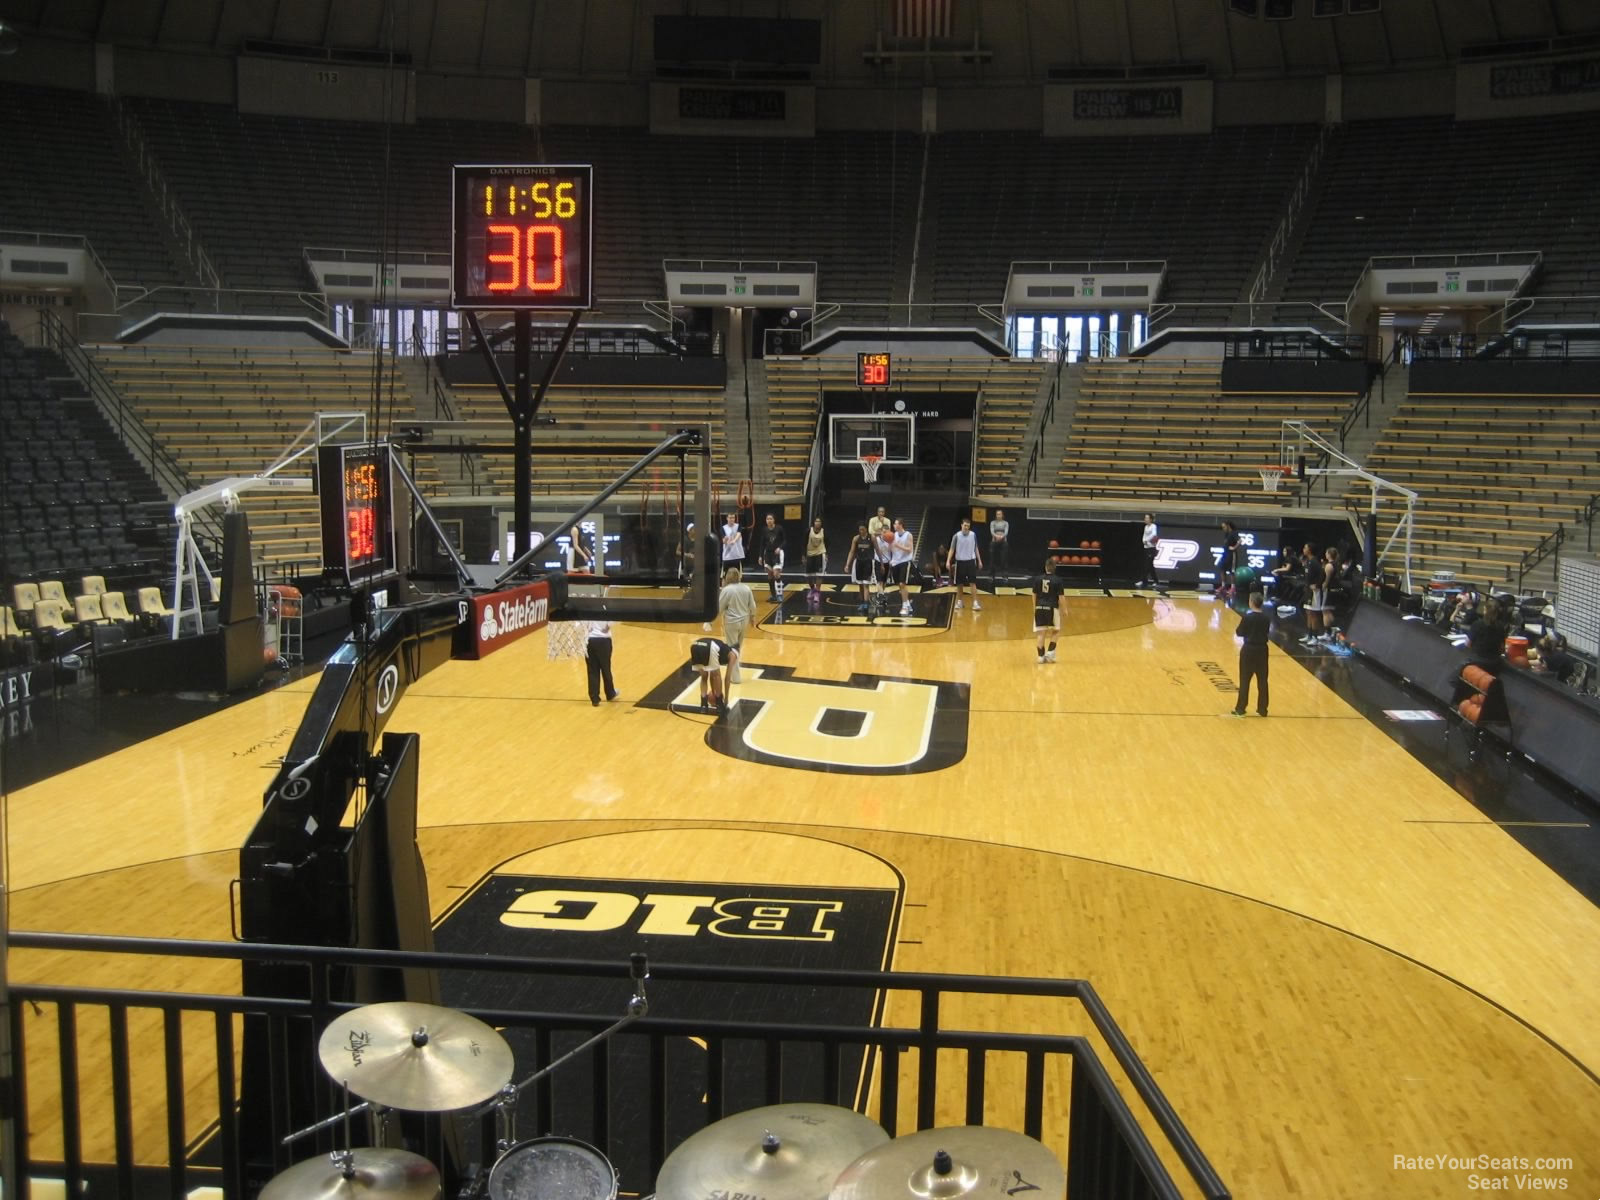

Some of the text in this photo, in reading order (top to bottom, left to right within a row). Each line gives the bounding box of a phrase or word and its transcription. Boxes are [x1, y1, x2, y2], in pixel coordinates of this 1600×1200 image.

[317, 72, 337, 83] 113
[485, 182, 576, 219] 11:56
[487, 225, 562, 291] 30
[863, 355, 888, 365] 11:56
[864, 365, 884, 383] 30
[349, 508, 375, 558] 30
[1153, 538, 1200, 569] P
[1248, 556, 1265, 568] 35
[1042, 579, 1051, 593] 15
[344, 1029, 370, 1067] Zildjian
